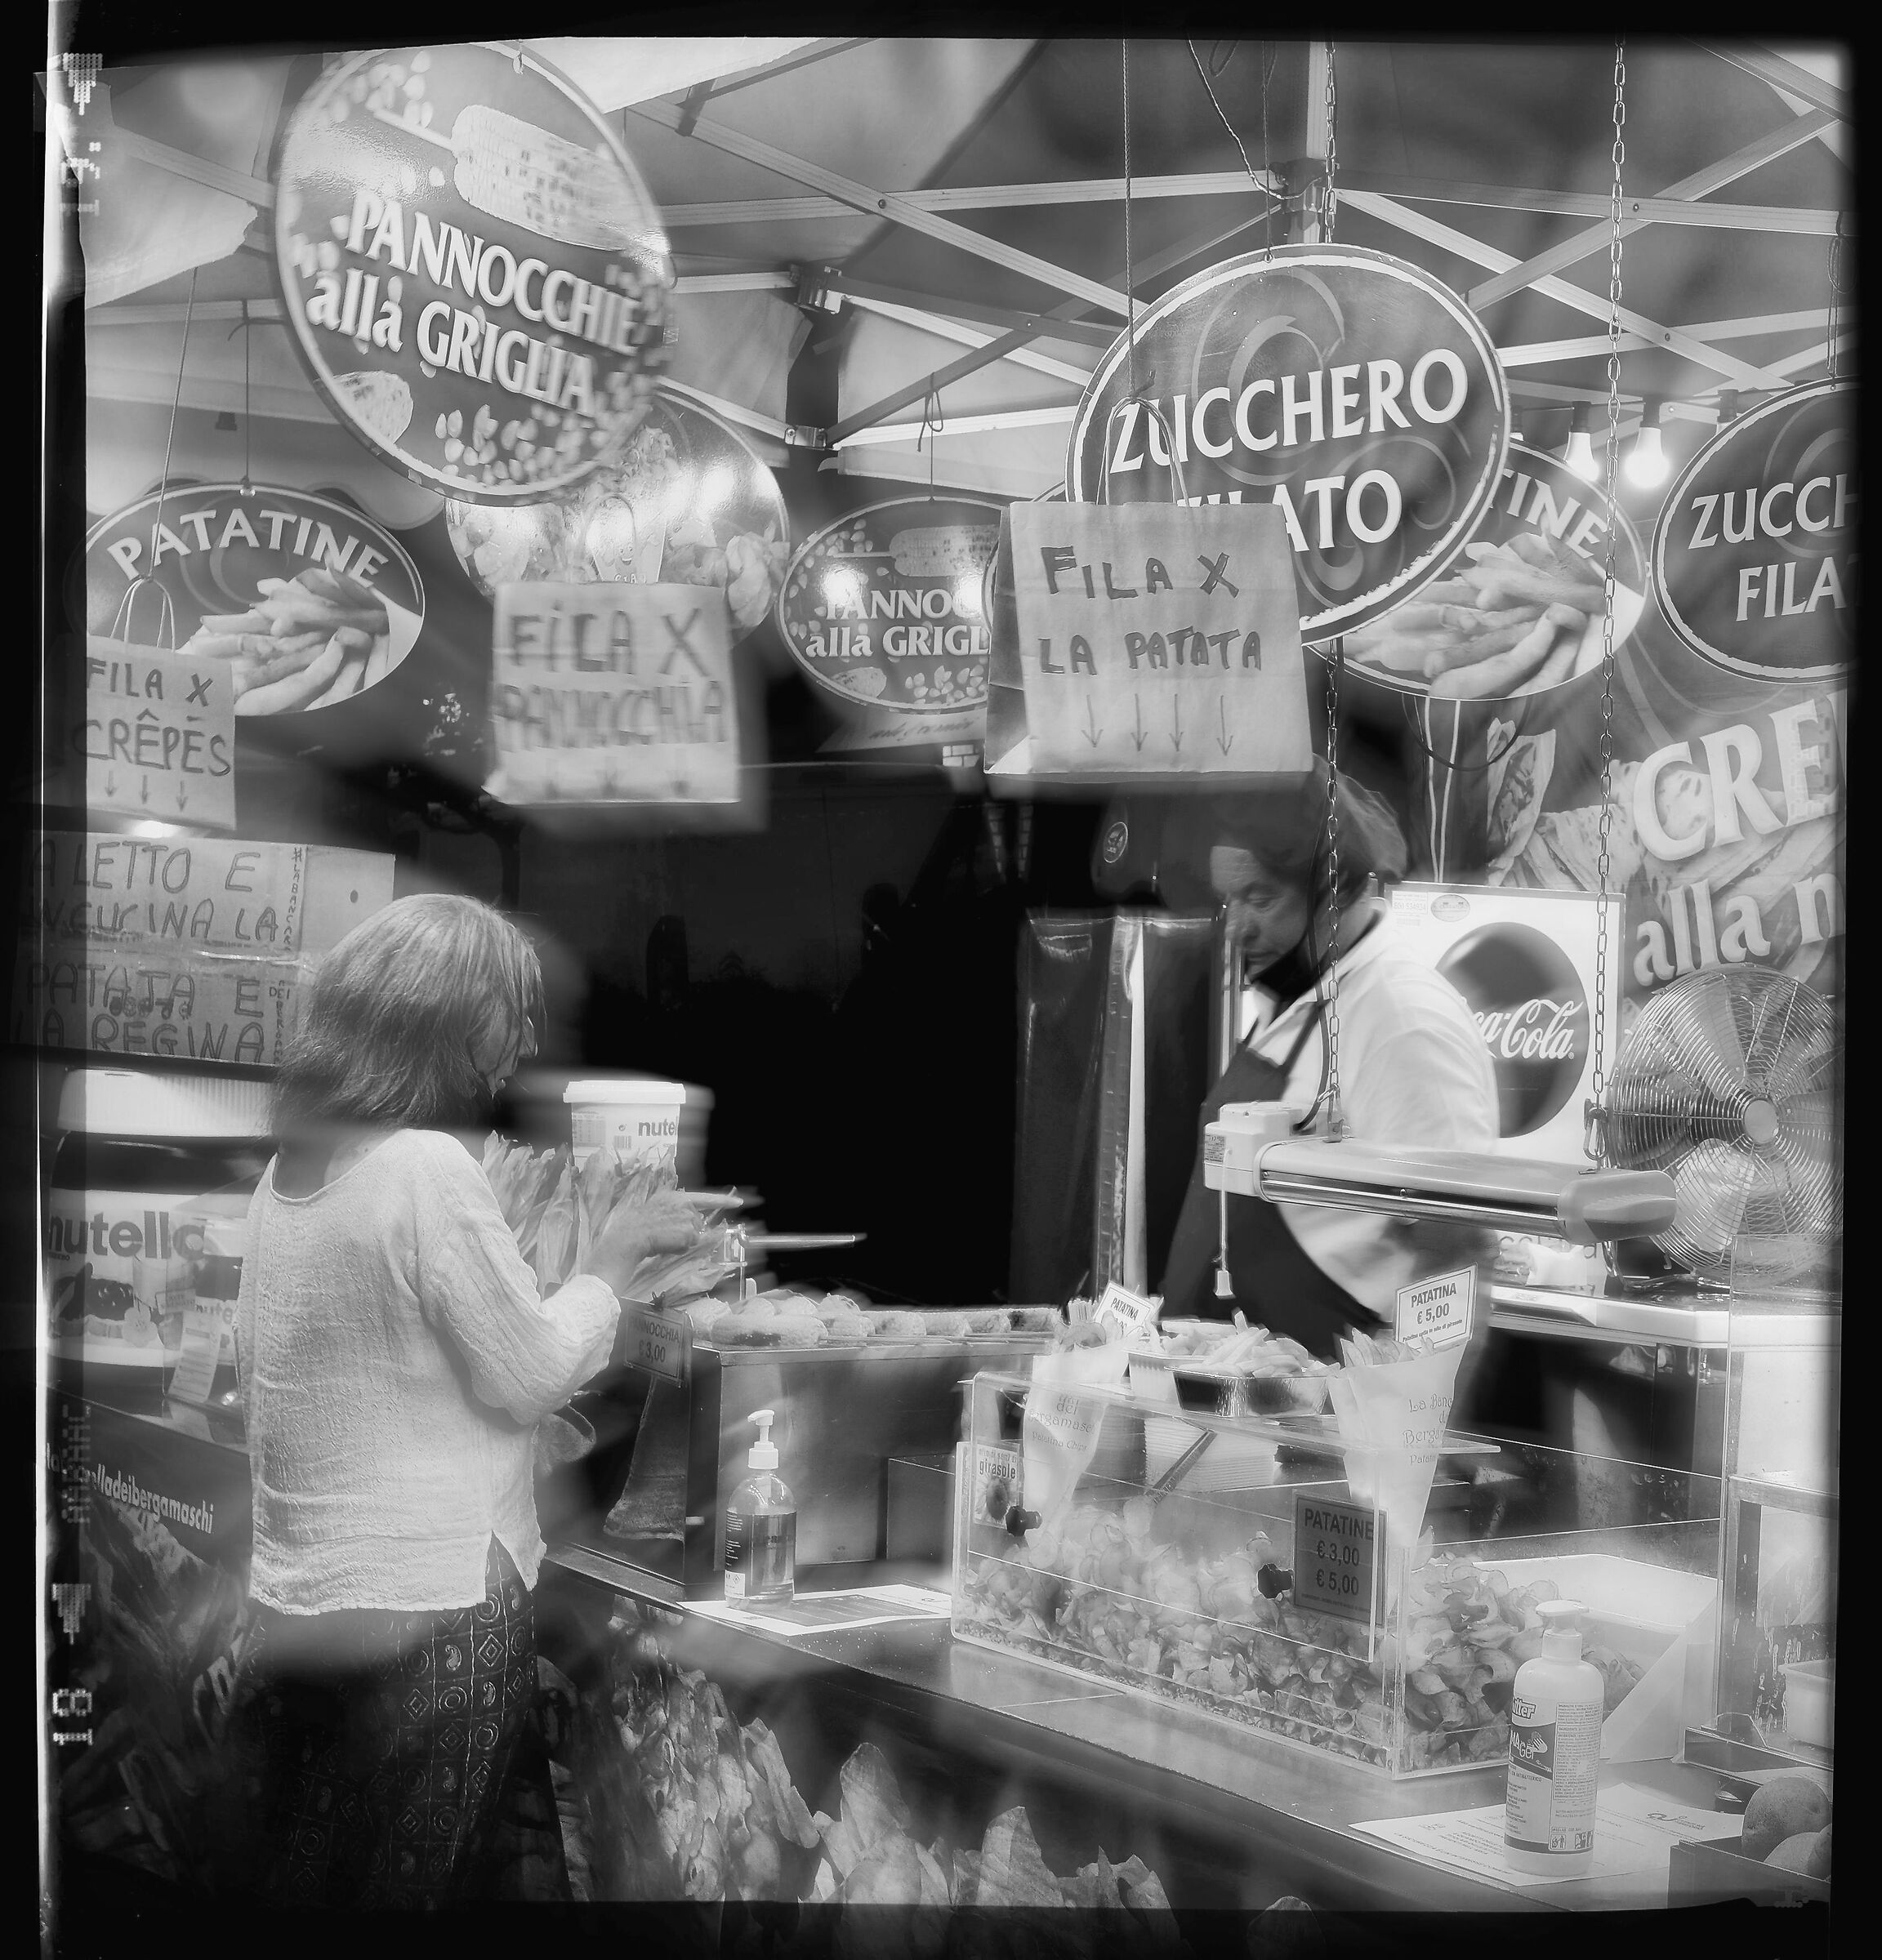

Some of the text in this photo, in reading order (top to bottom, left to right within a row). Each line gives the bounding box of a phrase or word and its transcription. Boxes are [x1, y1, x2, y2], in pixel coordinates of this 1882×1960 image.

[345, 189, 642, 357] PANNOCCHIE
[417, 301, 598, 417] GRIGLIA
[1109, 348, 1468, 474] ZUCCHERO
[106, 508, 390, 588] PATATINE
[1040, 546, 1240, 600] FILA X
[1736, 555, 1856, 621] FILA
[657, 607, 711, 678] X
[805, 626, 873, 657] alla
[1037, 626, 1262, 675] LA PATATA
[85, 656, 214, 708] FILA X
[1634, 689, 1847, 862] CRE
[74, 840, 192, 893] LETTO
[225, 852, 261, 893] E
[234, 906, 279, 942] LA
[1633, 878, 1772, 987] alla
[27, 960, 264, 1018] PATATA E
[91, 1013, 265, 1064] REGINA
[49, 1210, 206, 1261] nutella
[1110, 1297, 1139, 1321] PATATINA
[1411, 1282, 1457, 1308] PATATINA
[1425, 1303, 1450, 1323] 5,00
[979, 1458, 1017, 1479] girasole
[1304, 1508, 1375, 1541] PATATINE
[1329, 1543, 1360, 1566] 3,00
[1328, 1571, 1359, 1596] 5,00
